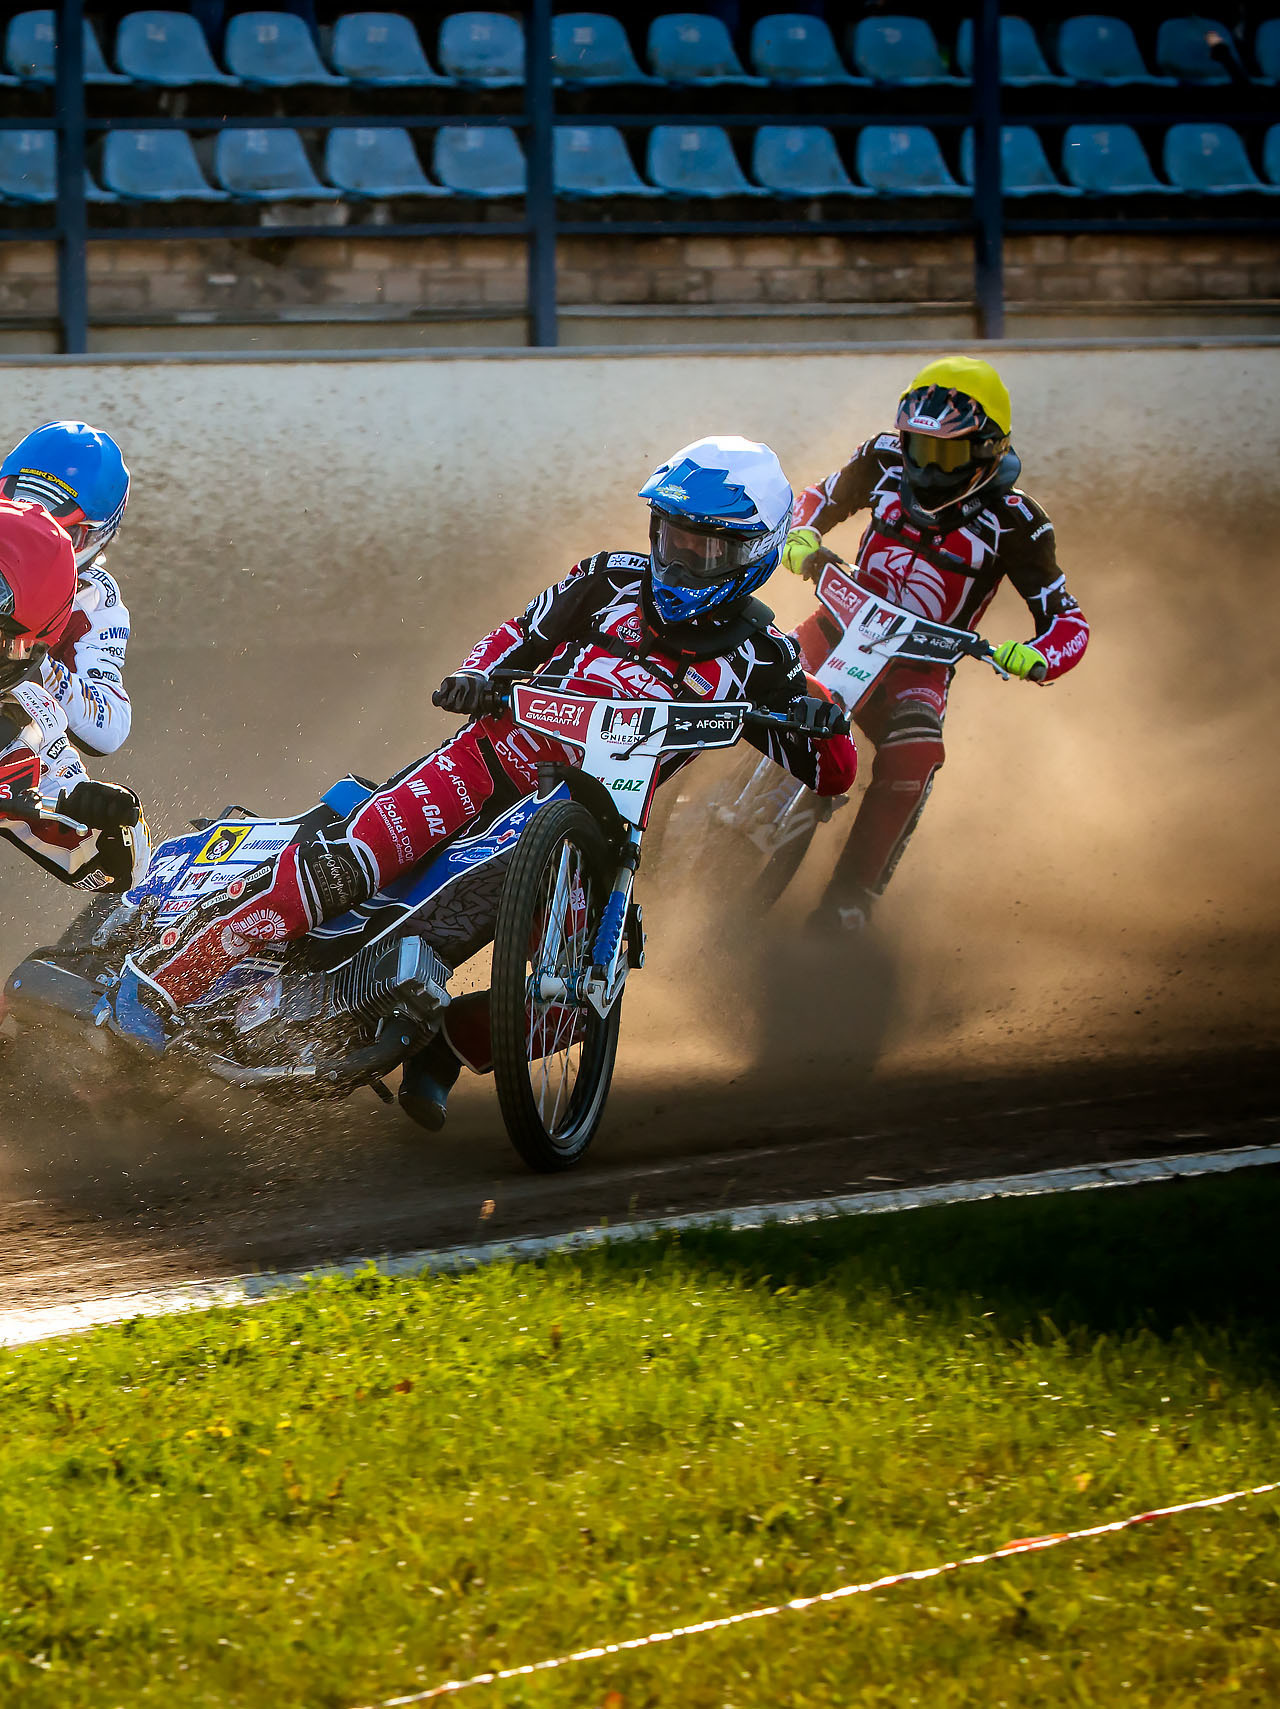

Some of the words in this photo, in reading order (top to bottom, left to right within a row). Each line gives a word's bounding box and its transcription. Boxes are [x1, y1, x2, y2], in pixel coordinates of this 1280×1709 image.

[617, 624, 642, 643] START
[828, 657, 872, 683] HIL-GAZ
[529, 700, 576, 718] CAR
[525, 713, 573, 727] GWARANT
[696, 718, 734, 731] AFORTI
[450, 774, 476, 816] AFORTI
[407, 779, 446, 837] HIL-GAZ
